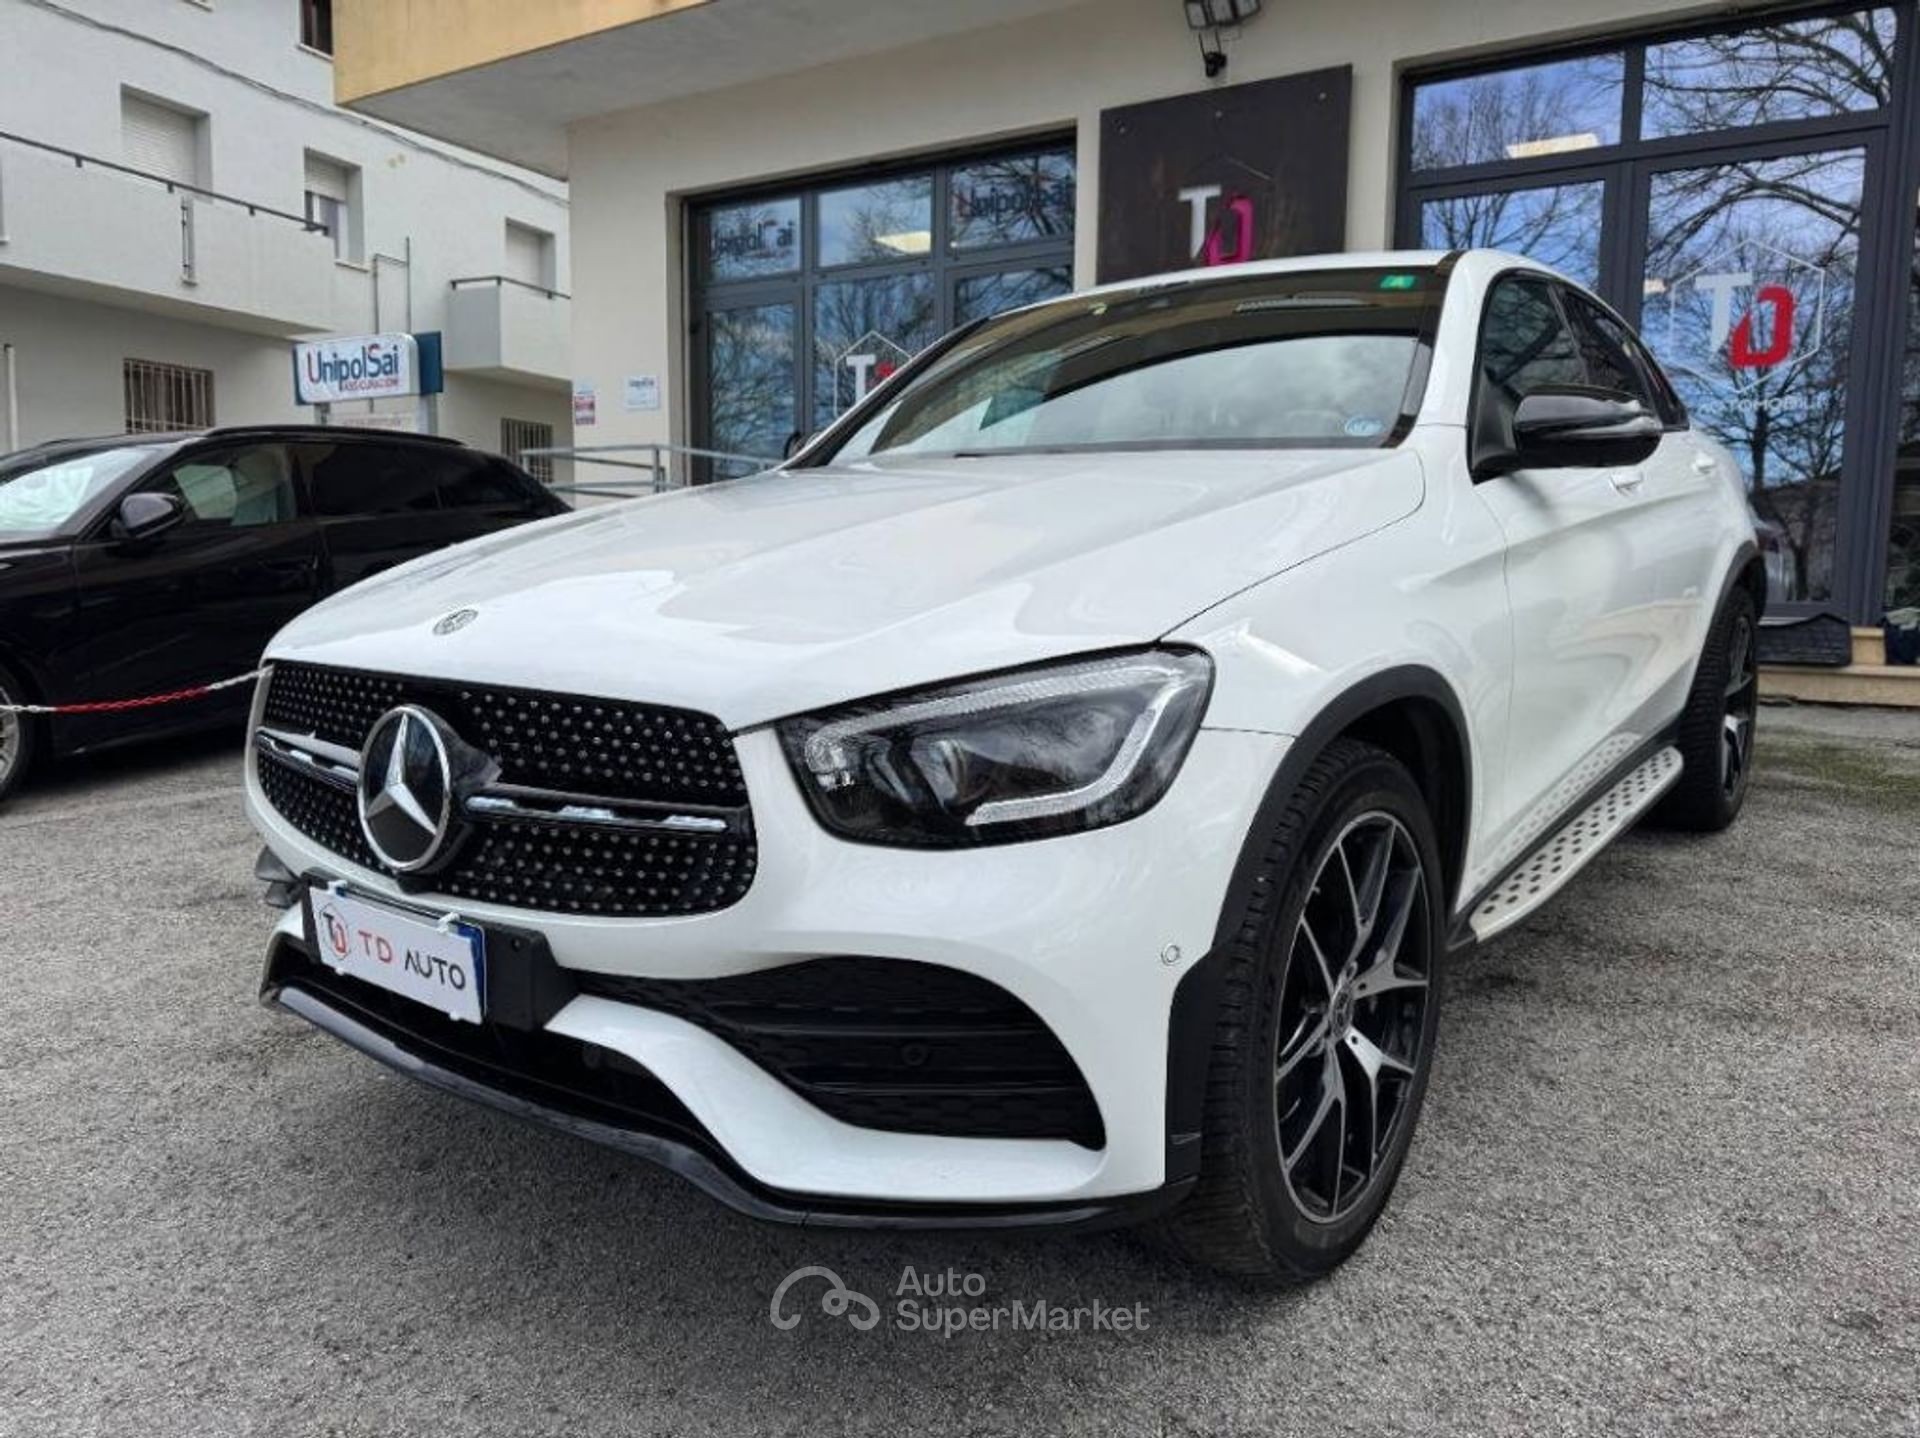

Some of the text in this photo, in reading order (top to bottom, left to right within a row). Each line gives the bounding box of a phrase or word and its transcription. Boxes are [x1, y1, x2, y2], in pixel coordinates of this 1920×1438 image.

[957, 174, 1072, 224] Unipolai
[307, 343, 399, 391] UnipolSai
[358, 930, 466, 990] TD AUTO
